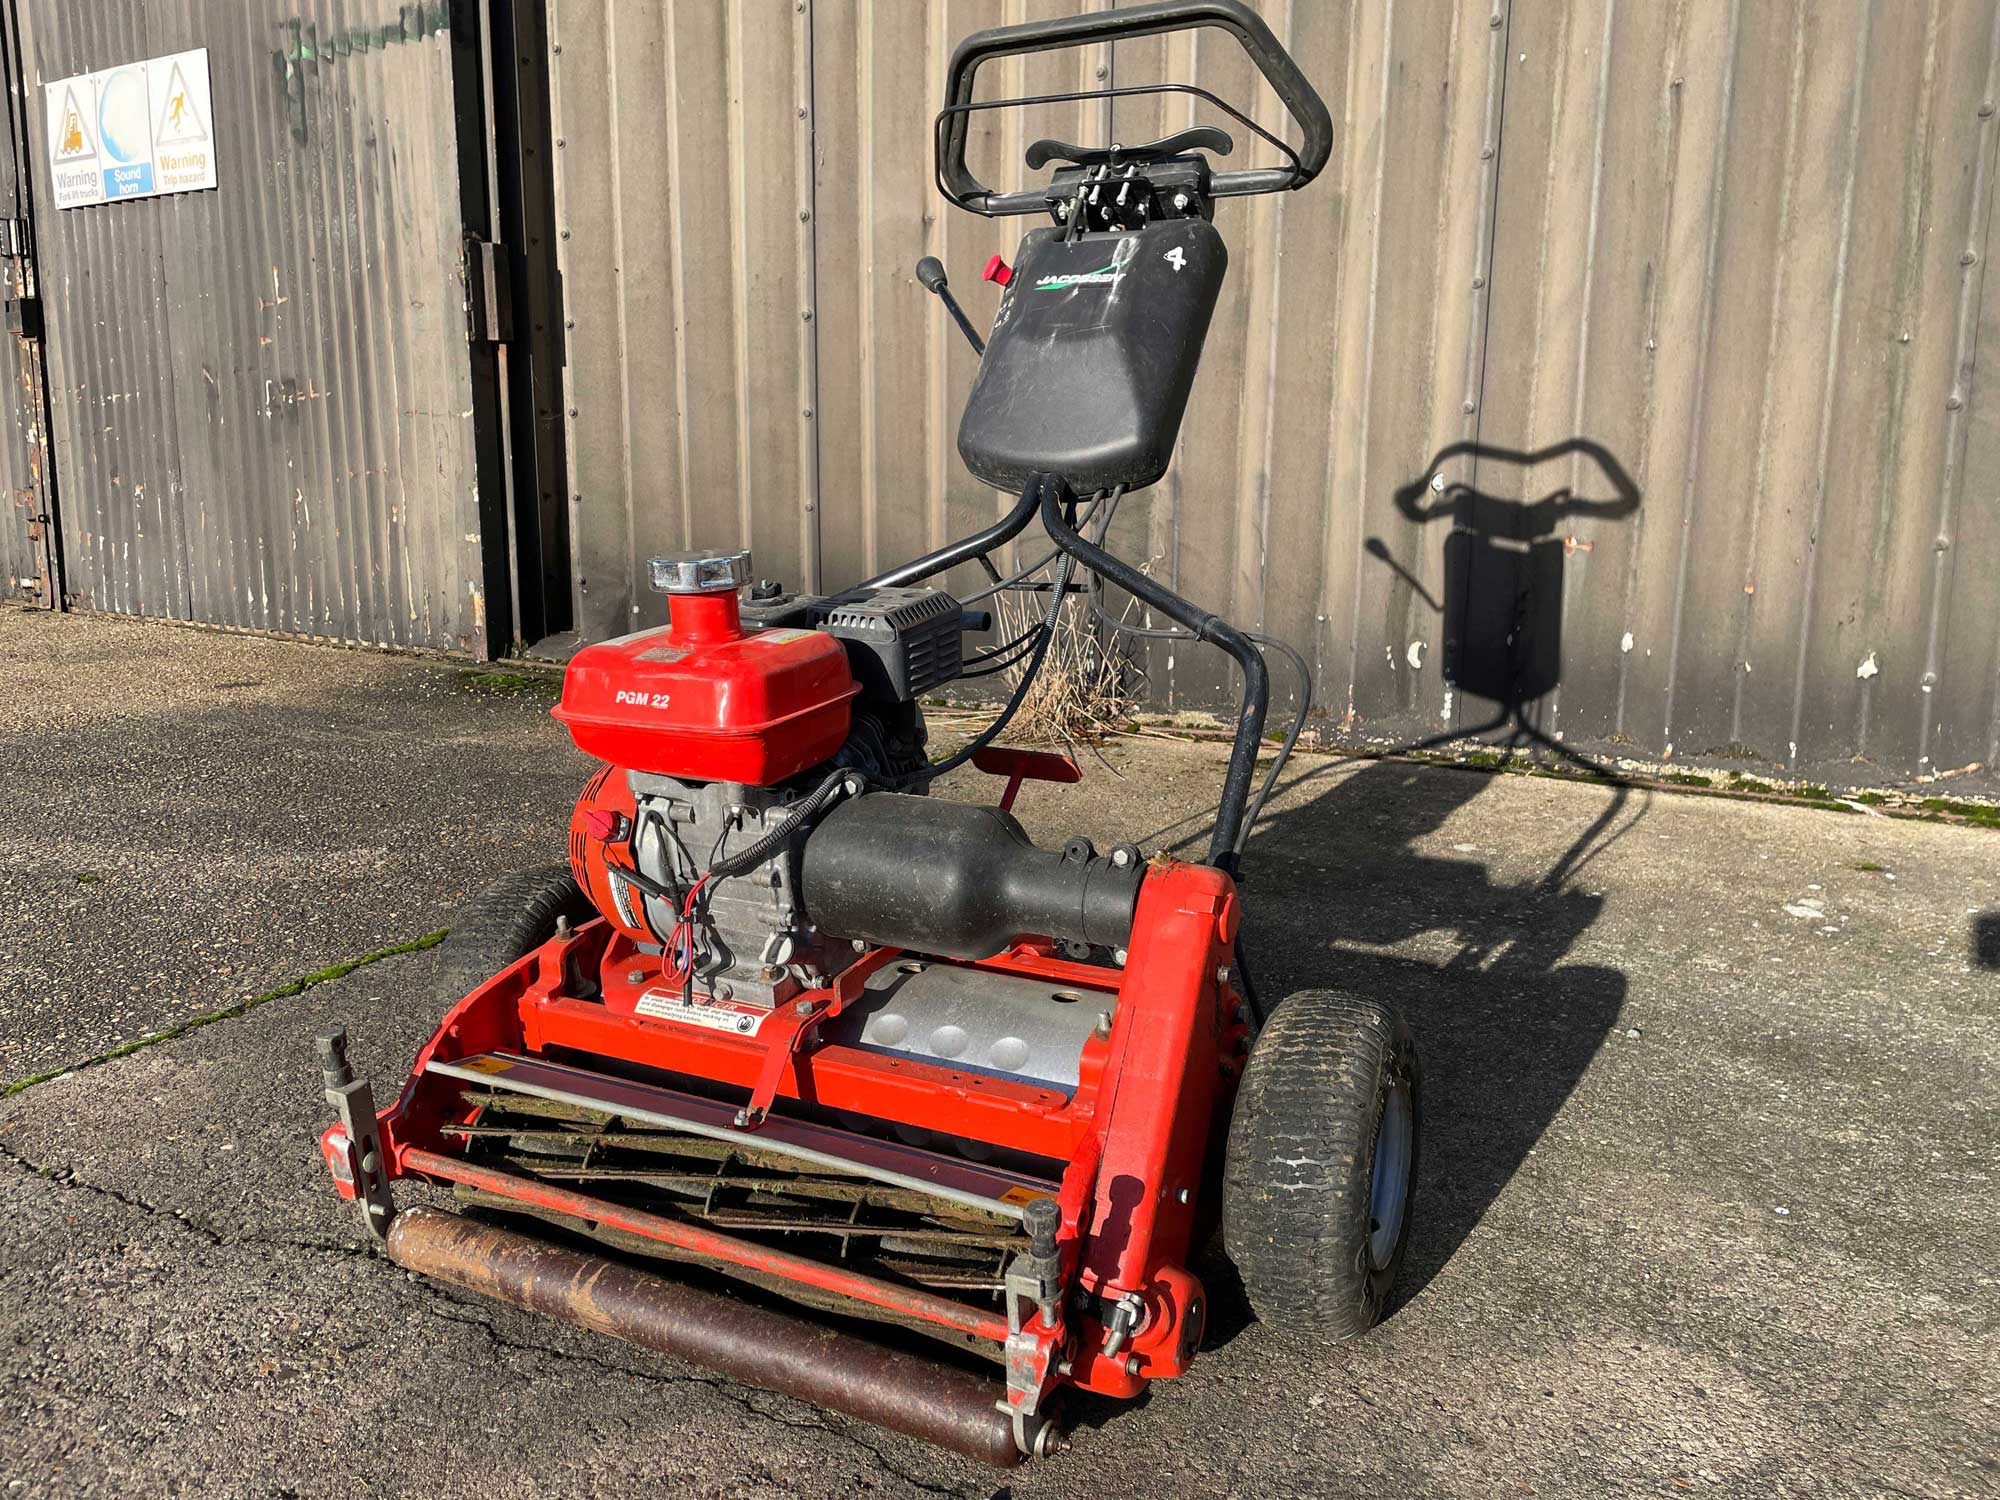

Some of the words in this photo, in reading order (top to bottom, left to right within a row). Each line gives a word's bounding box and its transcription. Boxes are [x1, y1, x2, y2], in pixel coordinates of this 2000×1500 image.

[160, 152, 205, 171] Warning
[57, 169, 97, 188] Warning
[114, 168, 141, 183] Sound
[164, 175, 178, 187] Trip
[179, 171, 205, 184] hazard
[59, 192, 71, 202] Fork
[80, 187, 98, 199] trucks
[120, 182, 138, 195] horn
[1163, 246, 1187, 272] 4
[1036, 272, 1127, 285] JACOBSEN
[615, 690, 649, 706] PGM
[650, 694, 670, 709] 22
